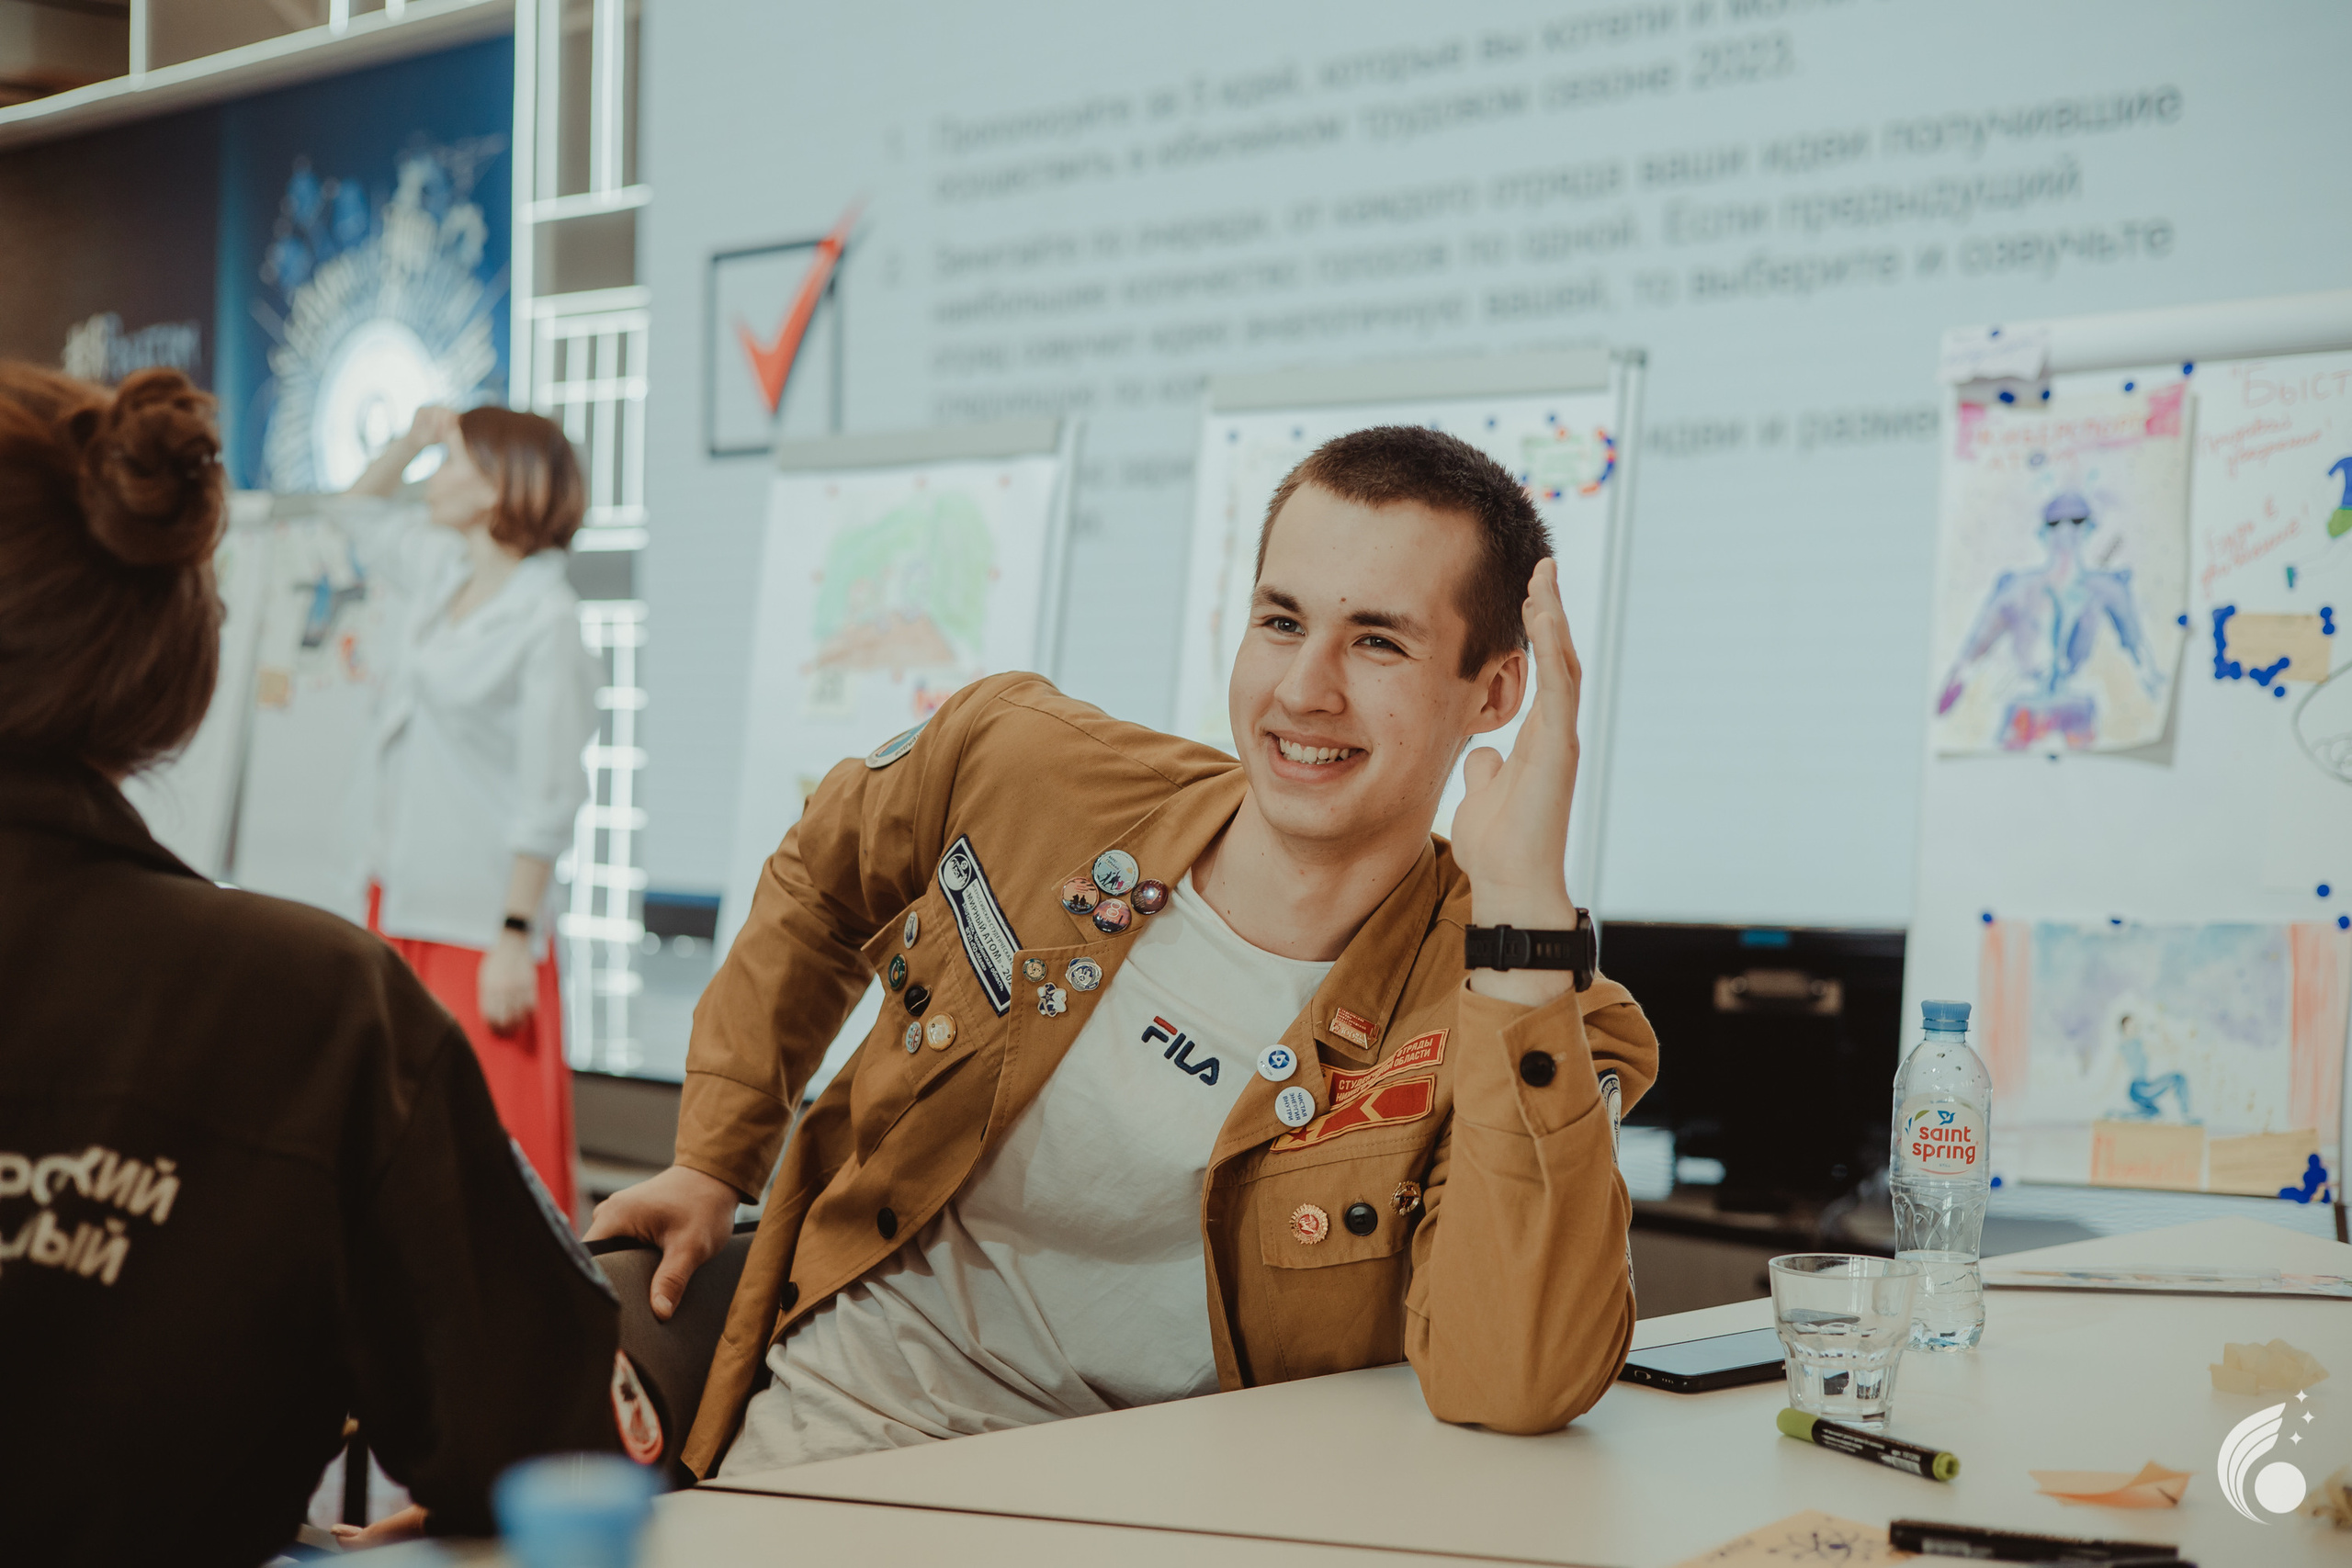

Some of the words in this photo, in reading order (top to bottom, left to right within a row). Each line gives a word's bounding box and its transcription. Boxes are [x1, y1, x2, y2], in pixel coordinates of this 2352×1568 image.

[1639, 144, 1749, 187] ваши
[1882, 83, 2185, 160] получившие
[1663, 194, 1771, 243] Если
[1781, 152, 2084, 237] предыдущий
[1689, 249, 1901, 304] выберите
[1958, 215, 2176, 282] озвучьте
[1141, 1015, 1220, 1086] FILA
[1394, 1048, 1431, 1067] ОБЛАСТИ
[1283, 1095, 1294, 1122] ВНУТРИ
[1289, 1092, 1301, 1121] ЭНЕРГИЯ
[1296, 1091, 1307, 1118] ЧИСТАЯ
[1919, 1126, 1972, 1143] saint
[1912, 1142, 1976, 1165] spring
